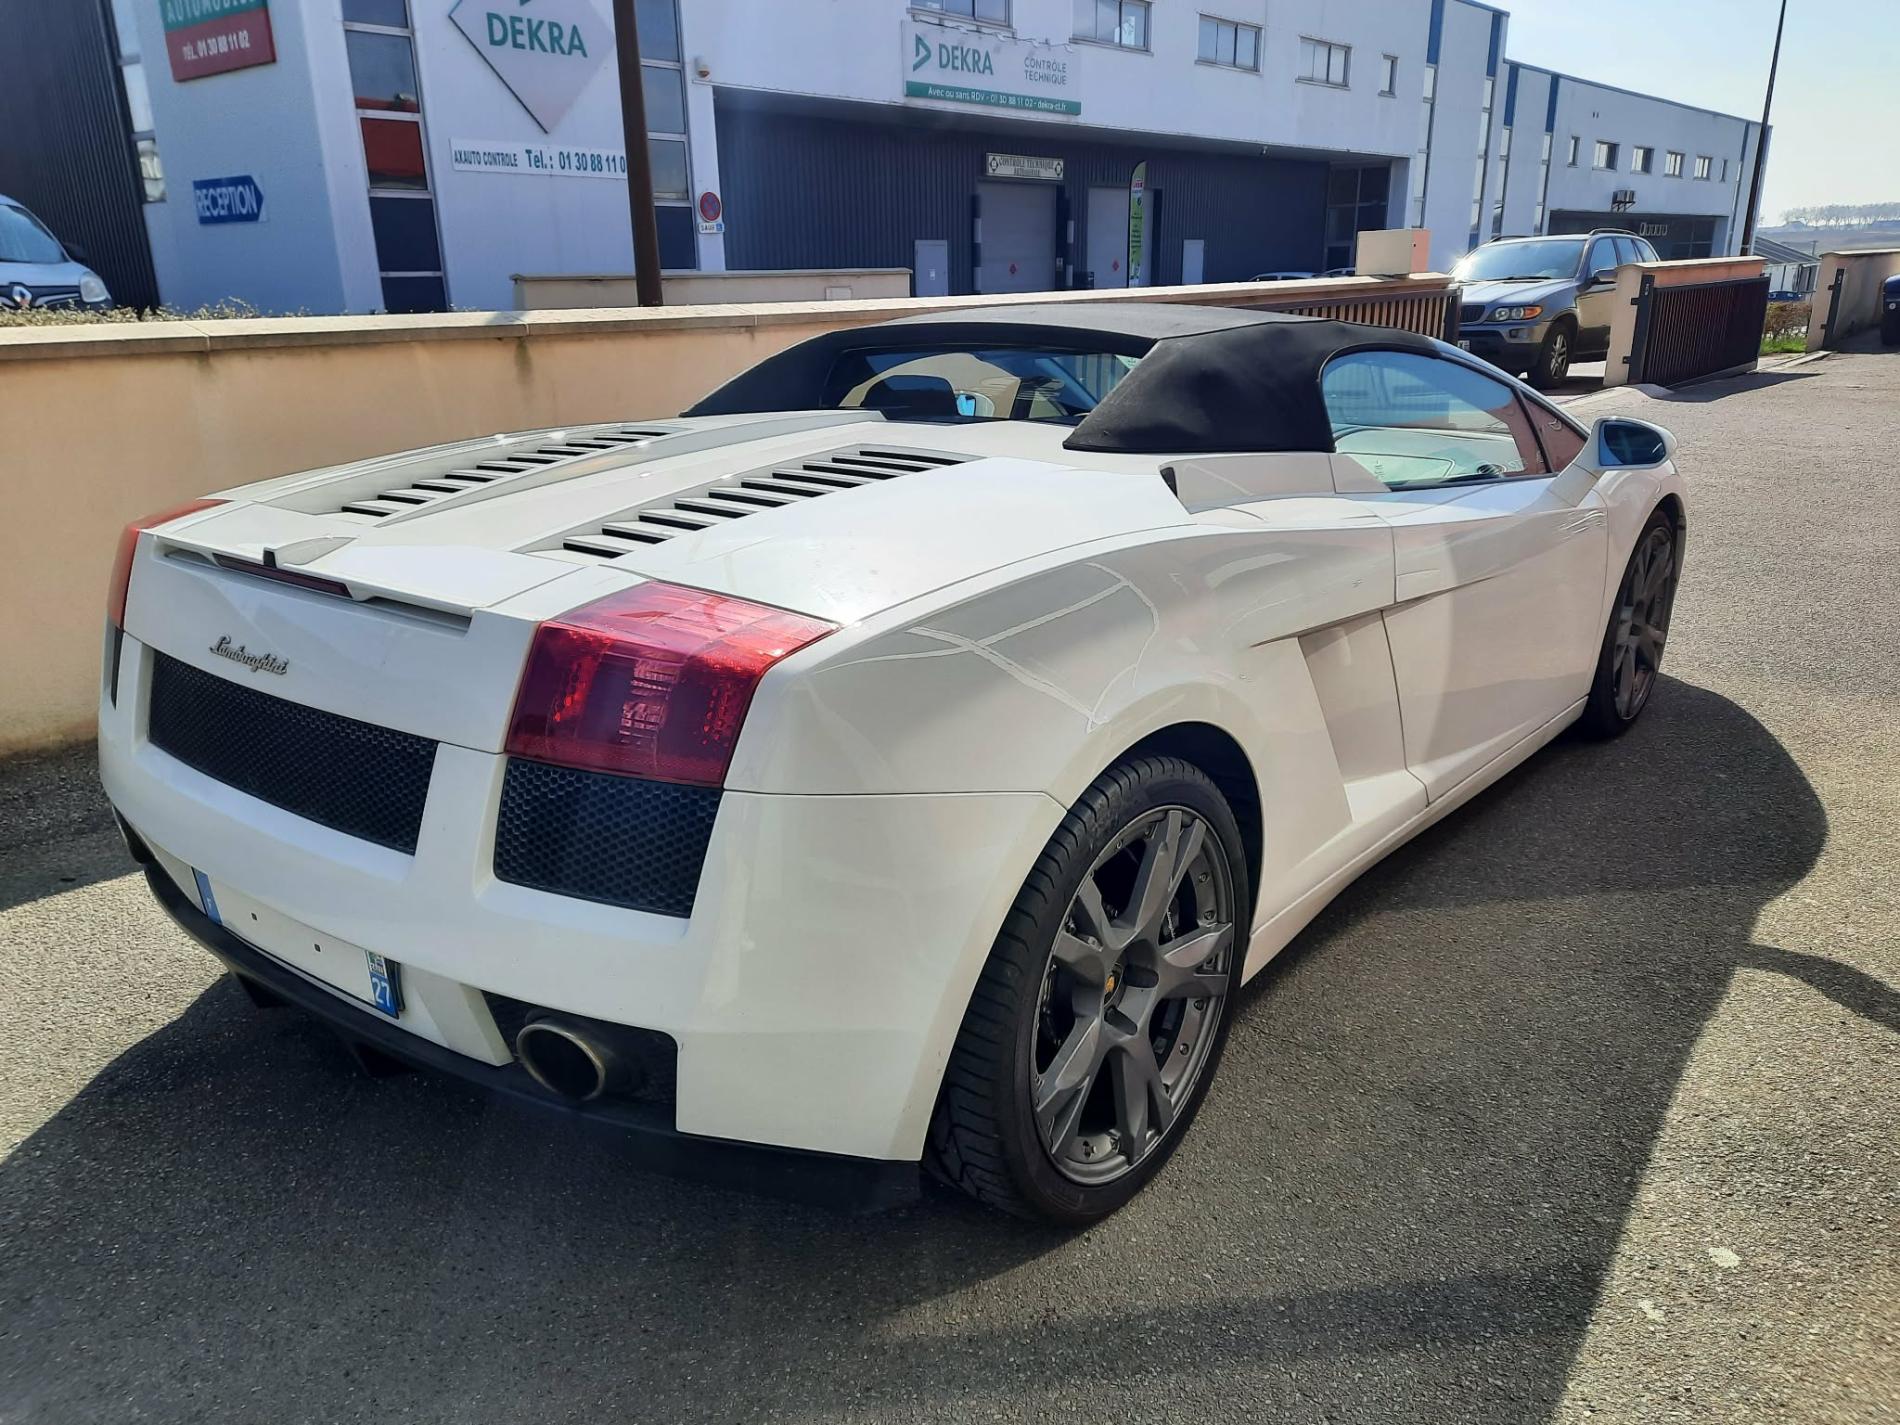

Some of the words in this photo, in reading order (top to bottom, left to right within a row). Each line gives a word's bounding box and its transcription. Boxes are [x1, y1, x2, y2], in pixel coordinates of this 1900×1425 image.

[486, 11, 589, 59] DEKRA
[938, 43, 994, 76] DEKRA
[1024, 69, 1067, 86] TECHNIQUE
[928, 86, 945, 97] Avec
[945, 90, 955, 98] ou
[955, 90, 970, 100] sans
[970, 91, 985, 101] RDV
[990, 94, 999, 103] 01
[999, 95, 1007, 104] 30
[1008, 96, 1017, 105] 88
[1017, 96, 1024, 106] 11
[1024, 98, 1033, 107] 02
[454, 149, 481, 165] AXAUTO
[482, 151, 518, 167] CONTROLE
[559, 151, 572, 170] 01
[574, 152, 588, 171] 30
[590, 153, 603, 172] 88
[605, 154, 617, 173] 11
[195, 184, 259, 217] RECEPTION
[209, 634, 290, 675] Lamborghini
[371, 977, 391, 1009] 27
